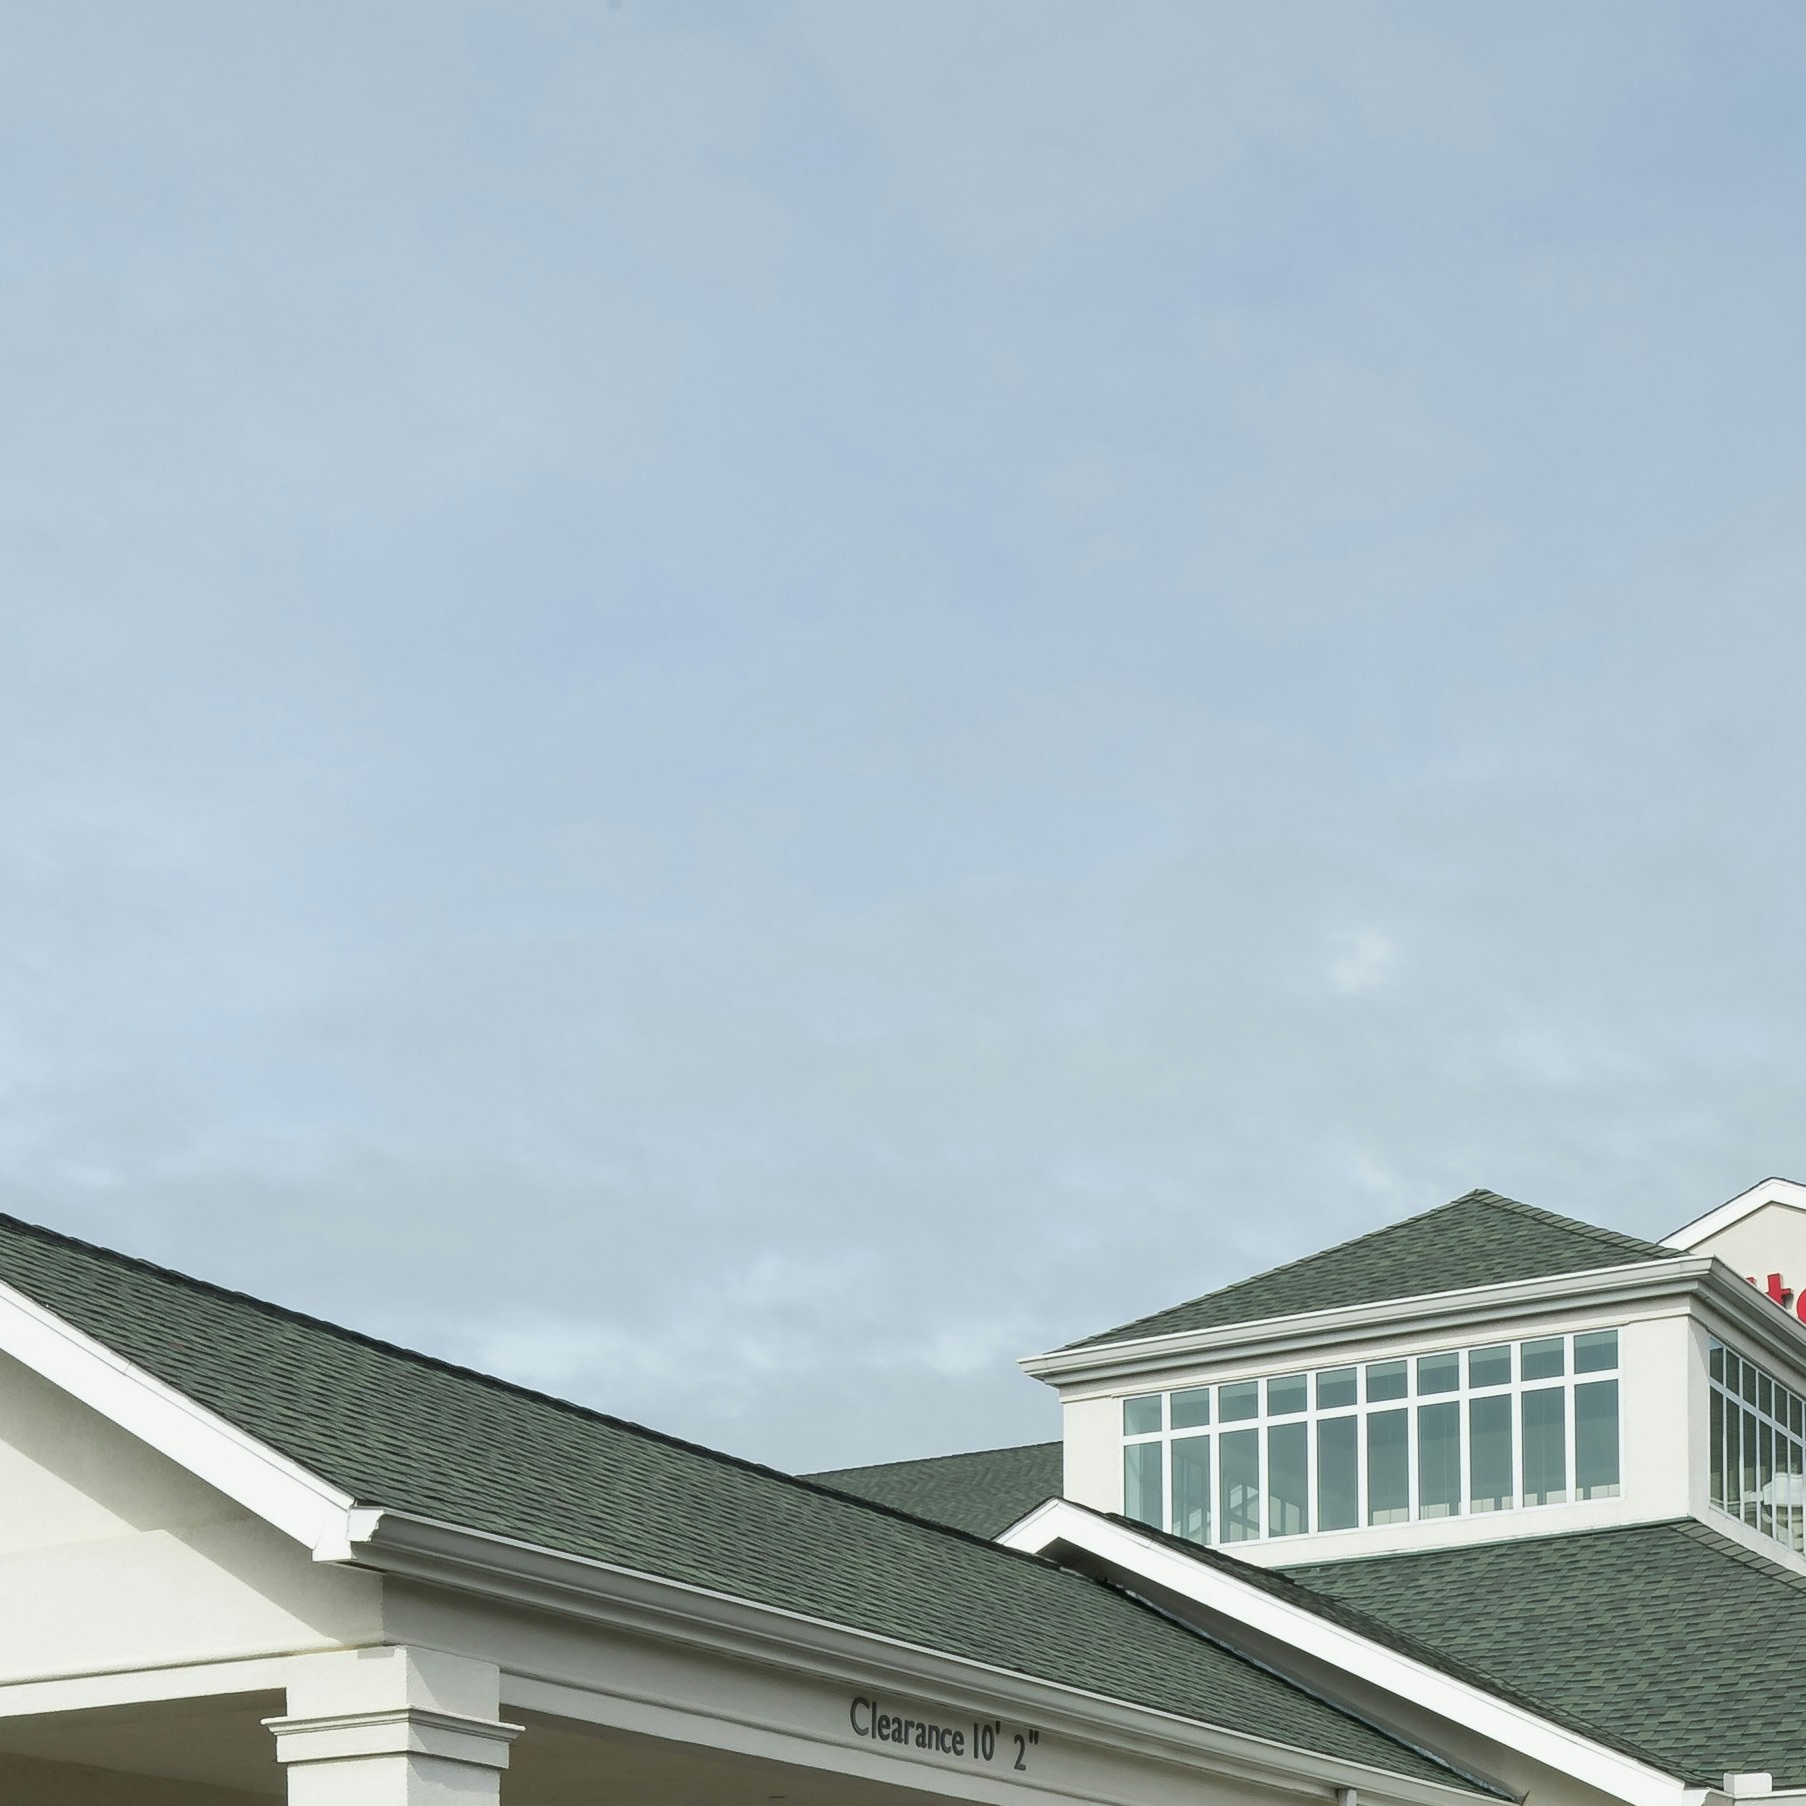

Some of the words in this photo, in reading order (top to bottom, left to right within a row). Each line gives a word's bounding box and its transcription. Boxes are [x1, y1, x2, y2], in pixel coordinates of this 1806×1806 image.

[850, 1697, 964, 1756] Clearance
[974, 1721, 1001, 1761] 10'
[1014, 1729, 1040, 1771] 2"
